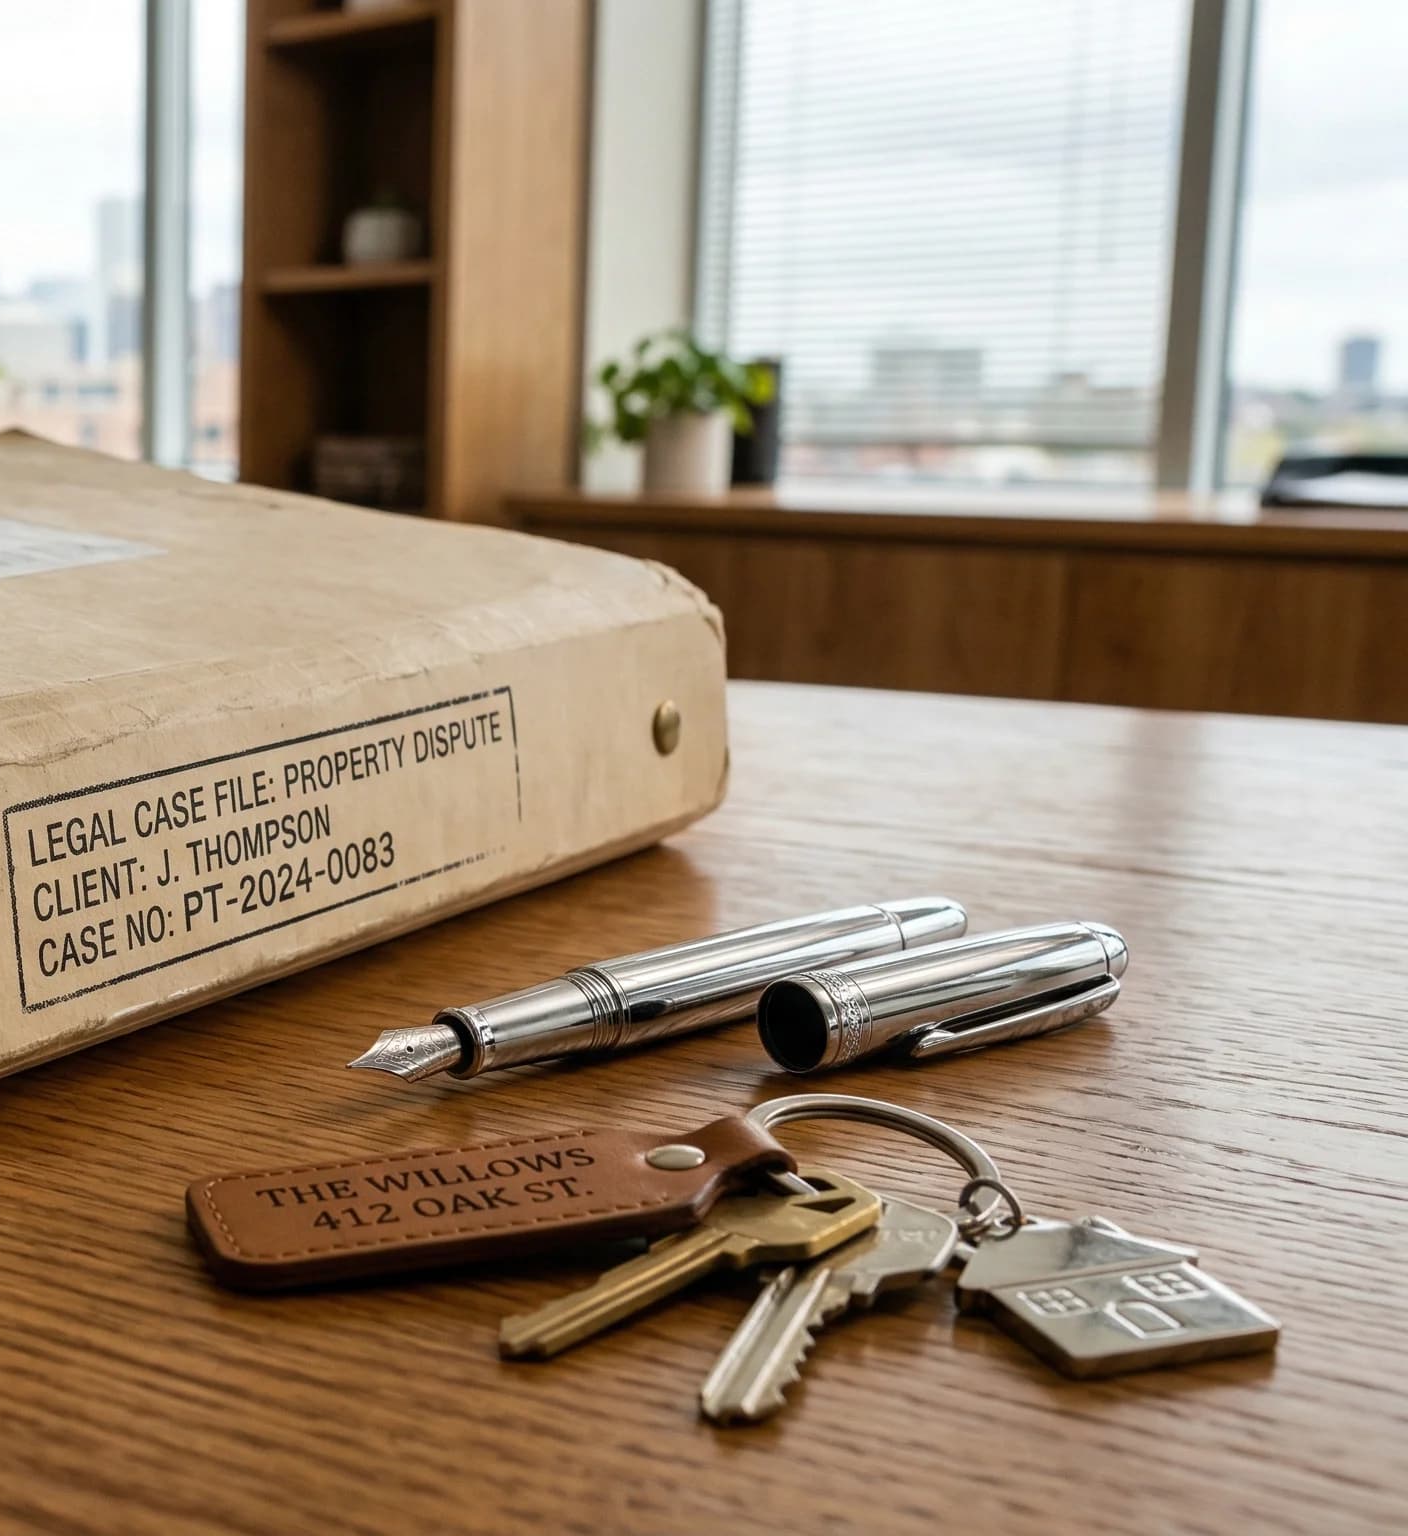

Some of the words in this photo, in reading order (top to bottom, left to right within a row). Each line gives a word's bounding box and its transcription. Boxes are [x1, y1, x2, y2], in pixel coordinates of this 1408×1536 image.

[26, 809, 127, 868] LEGAL
[133, 786, 207, 839] CASE
[214, 770, 276, 820] FILE:
[283, 735, 406, 800] PROPERTY
[413, 711, 503, 764] DISPUTE
[32, 857, 147, 922] CLIENT:
[156, 850, 180, 889] J.
[186, 804, 332, 876] THOMPSON
[38, 919, 115, 978] CASE
[126, 905, 175, 952] NO:
[183, 831, 396, 933] PT-2024-0083
[255, 1179, 359, 1208] THE
[364, 1146, 596, 1195] WILLOWS
[312, 1202, 401, 1232] 412
[412, 1186, 519, 1219] OAK
[523, 1175, 595, 1204] ST.
